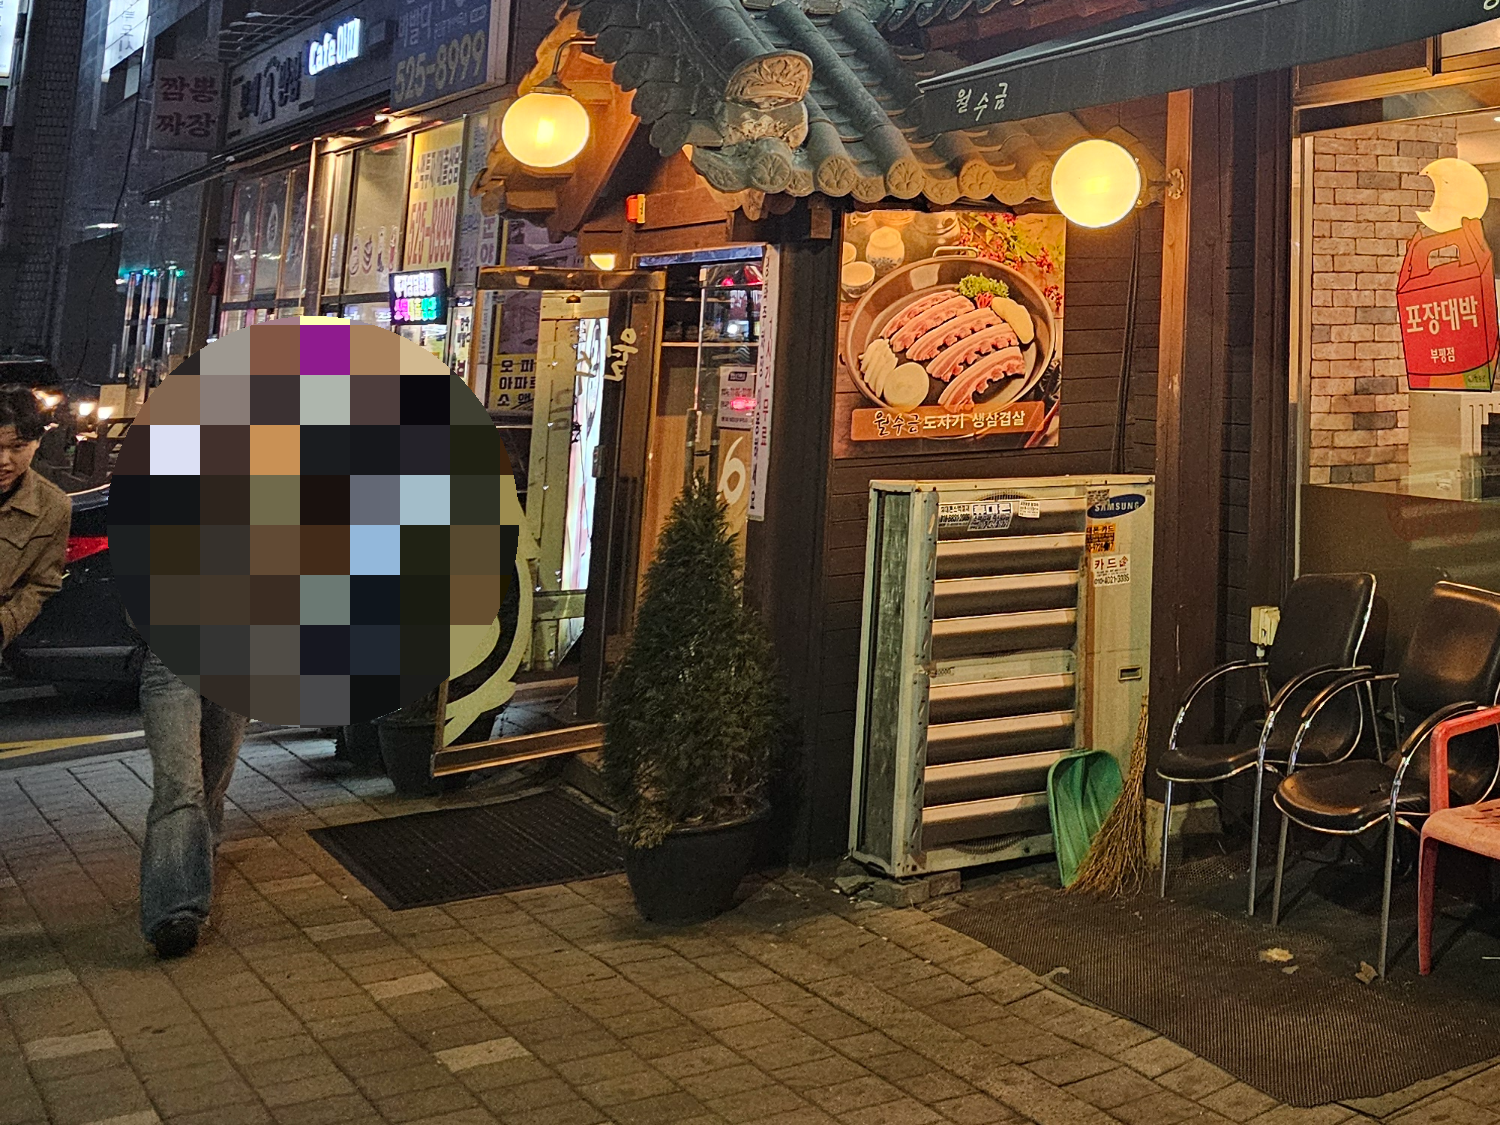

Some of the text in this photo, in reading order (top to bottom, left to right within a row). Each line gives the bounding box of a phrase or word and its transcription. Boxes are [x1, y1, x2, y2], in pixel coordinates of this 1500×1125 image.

[393, 29, 487, 104] 525-8999
[159, 76, 218, 104] 짬뽕
[955, 82, 1009, 122] 월수금
[156, 112, 218, 138] 짜장
[1405, 295, 1478, 335] 포장대박
[873, 410, 1026, 437] 월수금 도자기 생삼겹살
[1094, 501, 1140, 513] SAMSUNG
